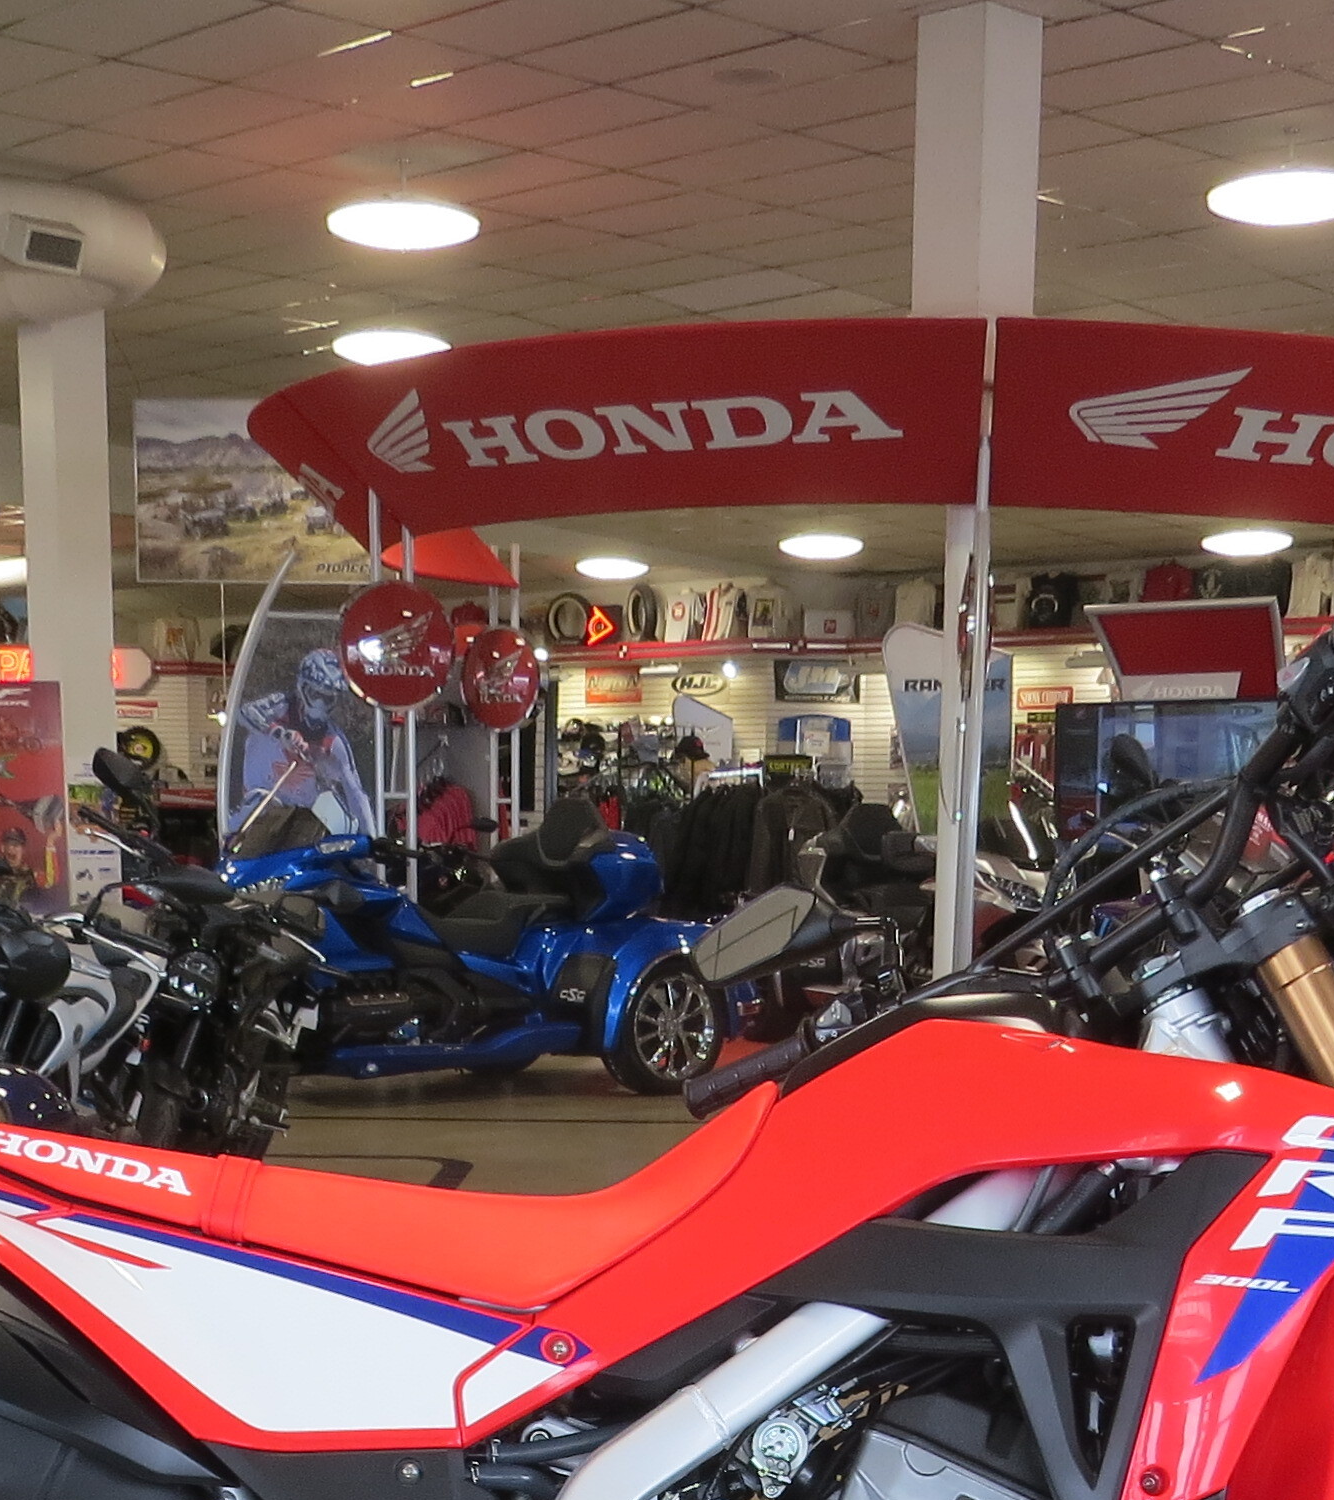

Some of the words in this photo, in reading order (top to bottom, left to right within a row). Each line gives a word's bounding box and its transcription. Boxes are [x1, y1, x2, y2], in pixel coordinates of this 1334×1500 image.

[442, 389, 904, 468] HONDA
[364, 664, 436, 678] HONDA
[1153, 685, 1226, 699] HONDA
[1193, 1273, 1302, 1294] 300L
